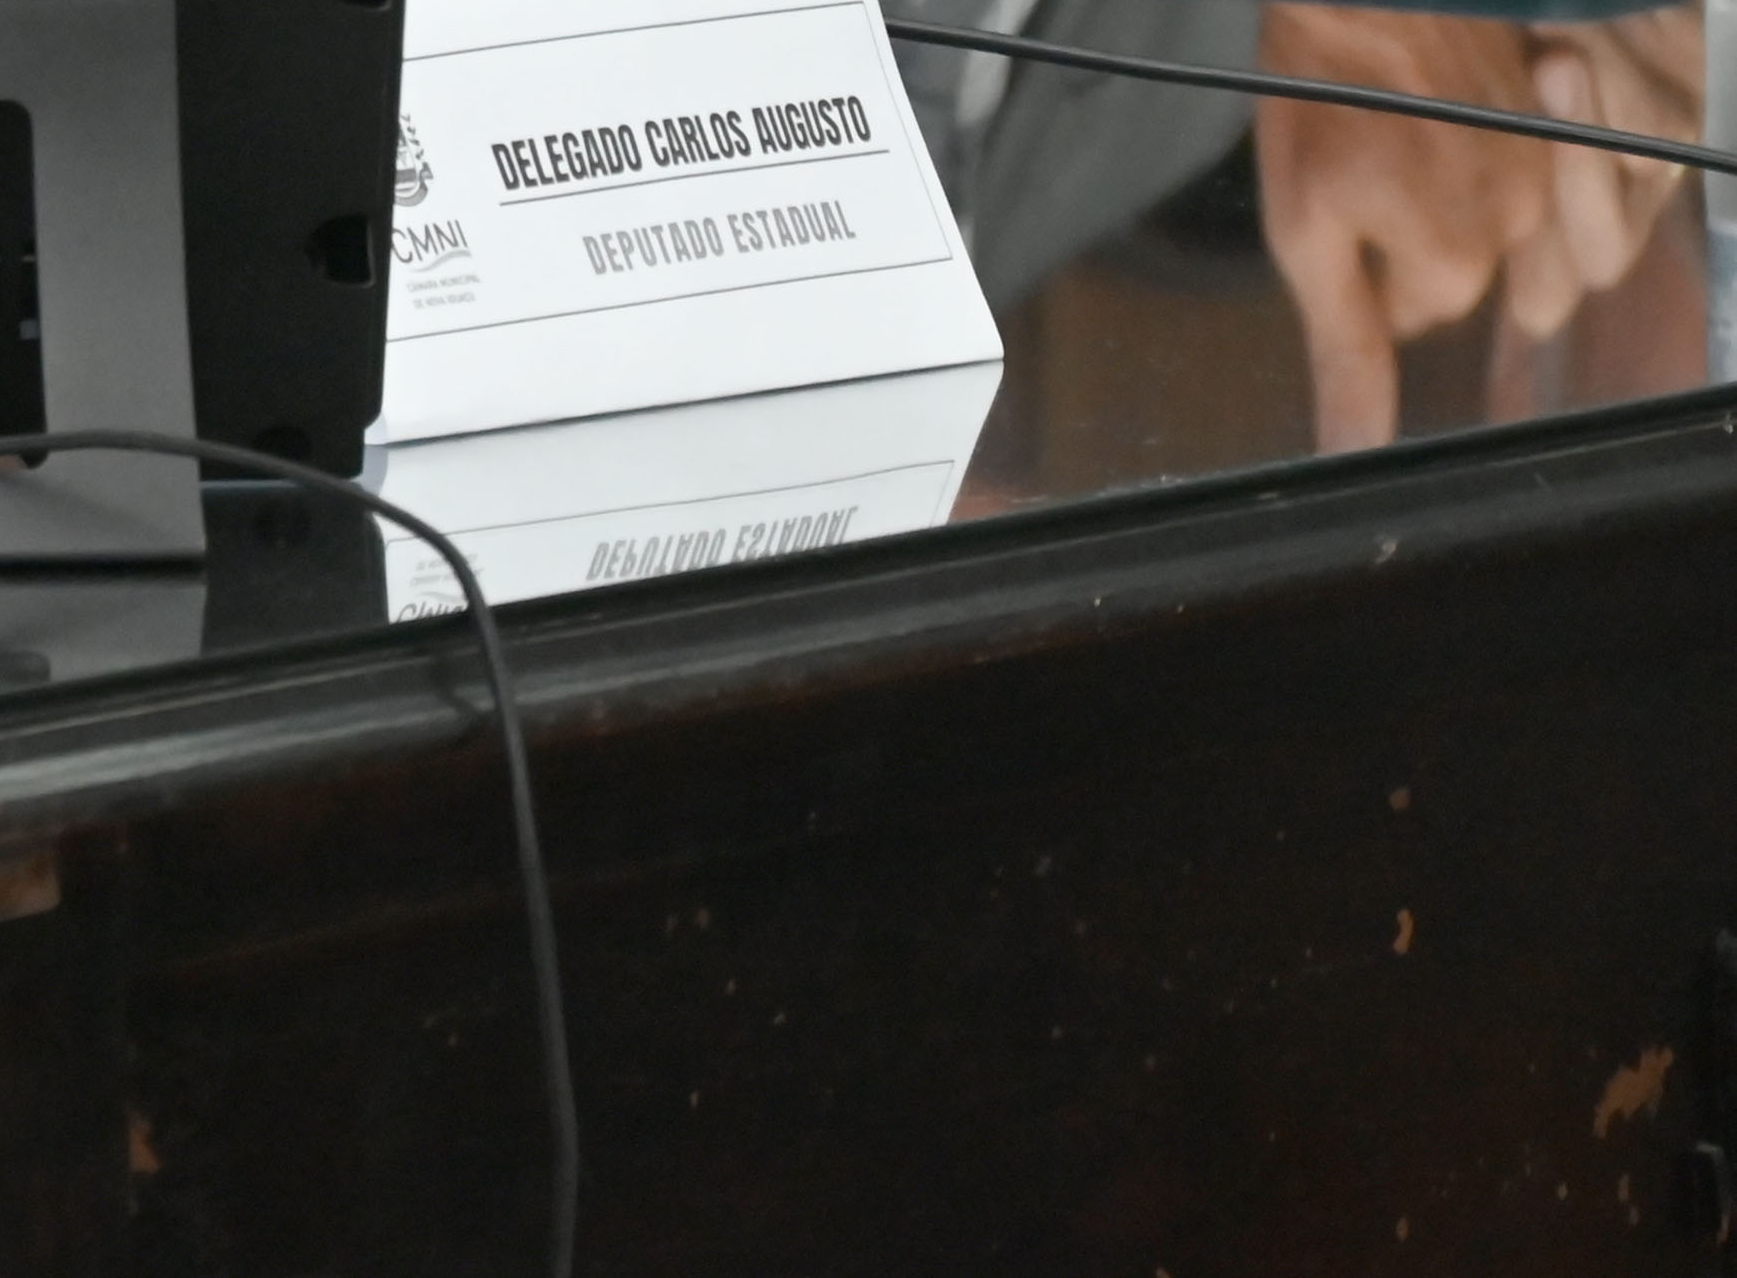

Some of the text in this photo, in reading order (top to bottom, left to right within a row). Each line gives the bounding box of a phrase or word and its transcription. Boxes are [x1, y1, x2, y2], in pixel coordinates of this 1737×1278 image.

[491, 95, 872, 191] DELEGADO CARLOS AUGUSTO
[391, 219, 468, 263] CMNI
[582, 200, 857, 275] DEPUTADO ESTADUAL
